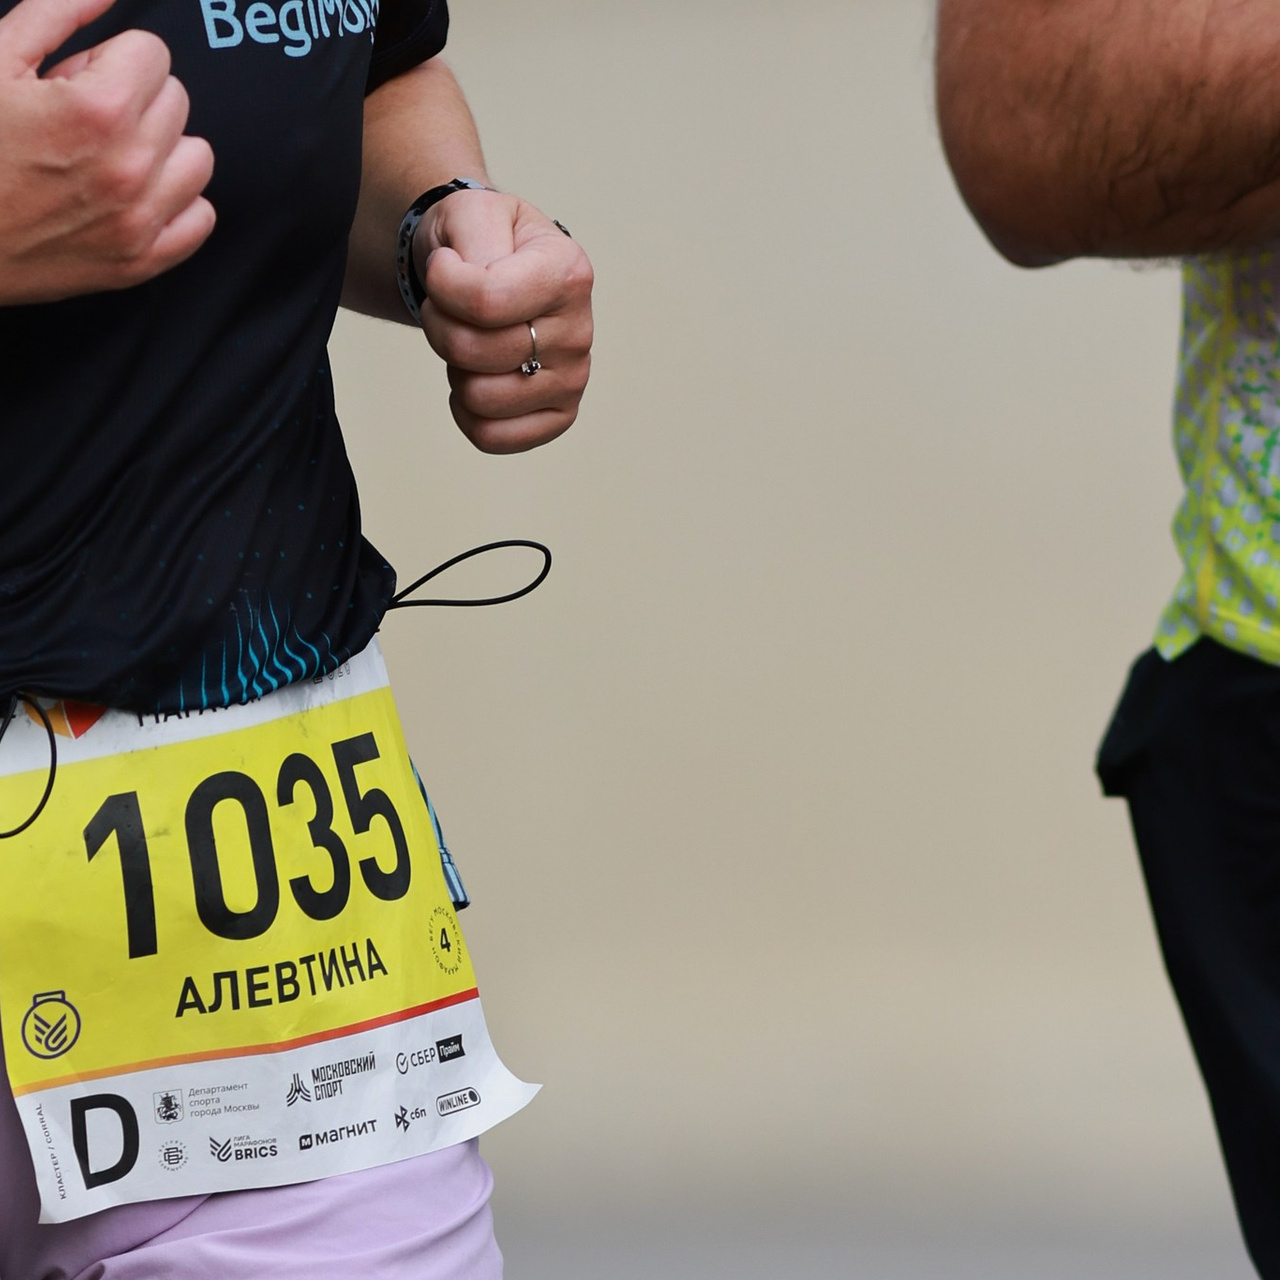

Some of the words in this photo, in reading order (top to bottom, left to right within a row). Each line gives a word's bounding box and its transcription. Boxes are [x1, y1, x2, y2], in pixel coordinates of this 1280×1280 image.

[83, 732, 412, 959] 1035
[440, 927, 451, 953] 4
[175, 938, 389, 1018] АЛЕВТИНА
[311, 1051, 376, 1084] МОСКОВСКИЙ
[410, 1047, 436, 1067] СБЕР
[188, 1083, 248, 1097] Департамент
[314, 1079, 343, 1101] СПОРТ
[189, 1097, 221, 1107] спорта
[190, 1107, 222, 1118] города
[224, 1103, 260, 1113] Москвы
[439, 1093, 469, 1112] WINLINE
[36, 1103, 52, 1144] CORRAL
[410, 1108, 427, 1120] сбп
[70, 1093, 140, 1191] D
[235, 1145, 278, 1160] BRICS
[50, 1153, 67, 1200] КЛАСТЕР
